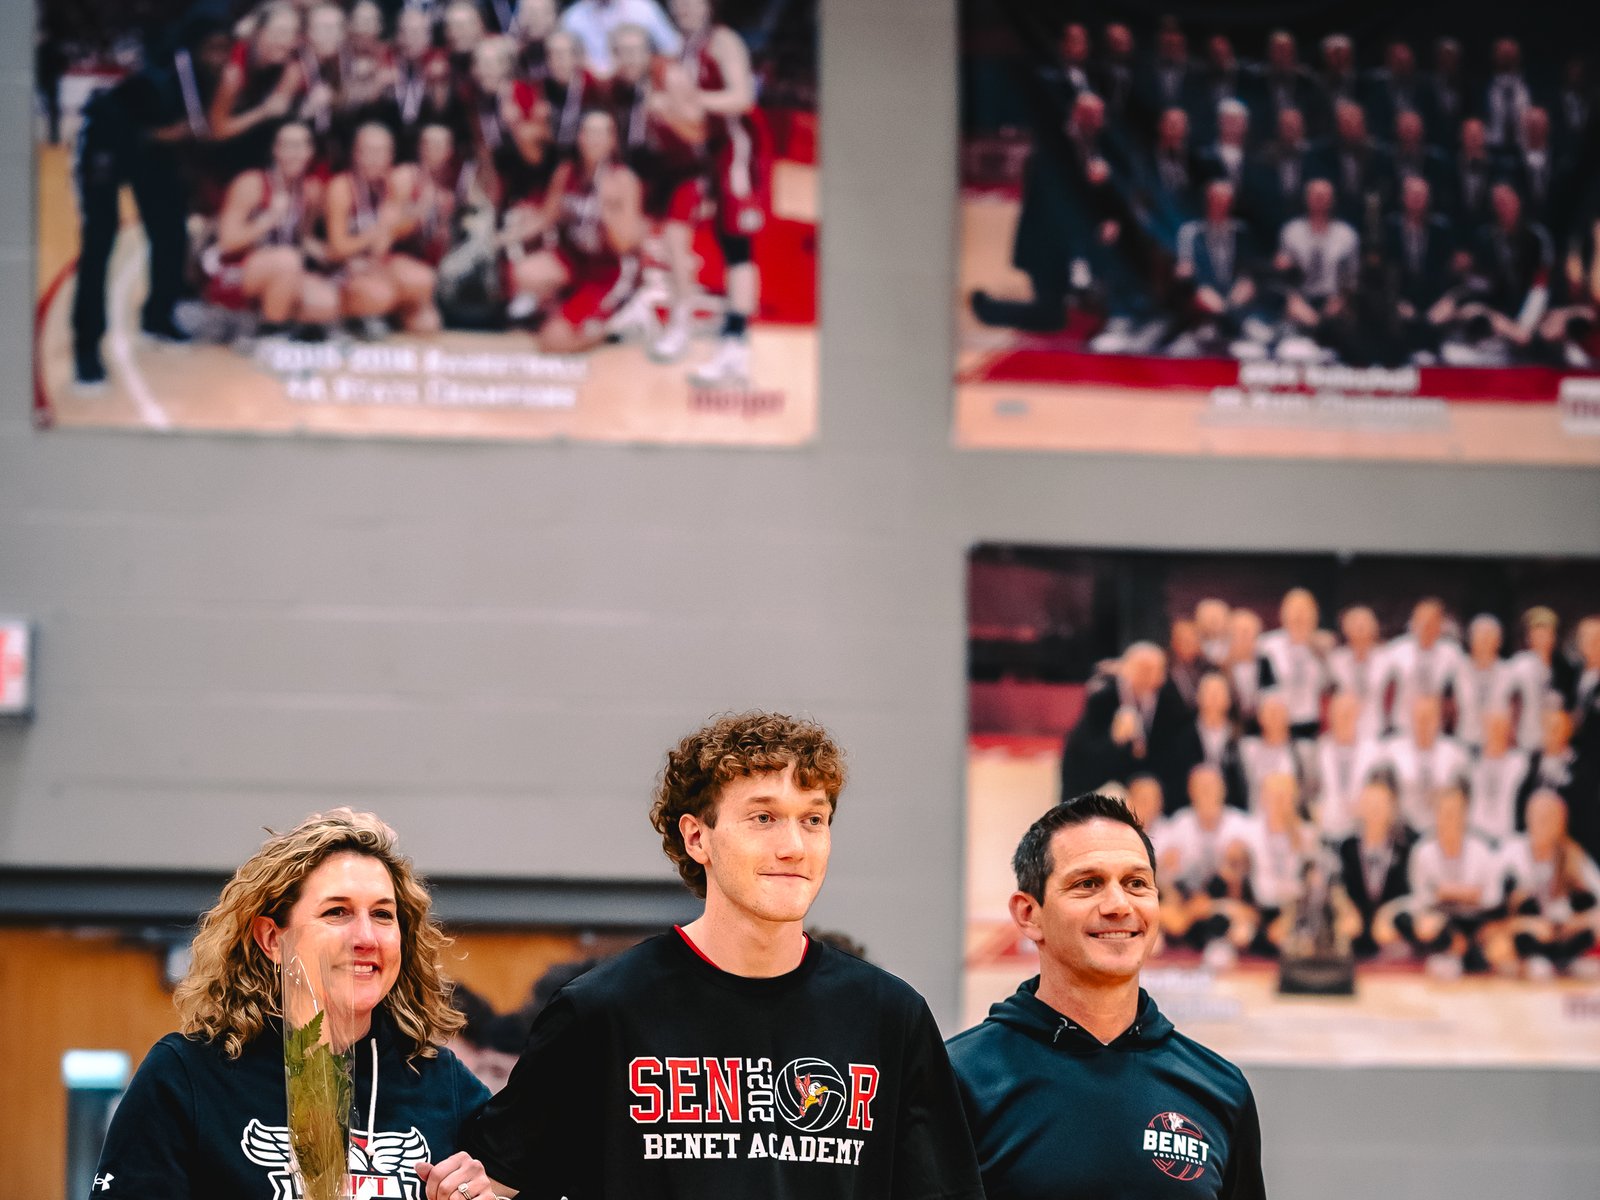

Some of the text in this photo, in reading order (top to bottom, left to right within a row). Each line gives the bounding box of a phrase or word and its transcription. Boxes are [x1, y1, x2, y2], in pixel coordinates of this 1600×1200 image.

[746, 1057, 775, 1123] 2025
[643, 1132, 865, 1166] BENET ACADEMY
[1143, 1129, 1209, 1161] BENET
